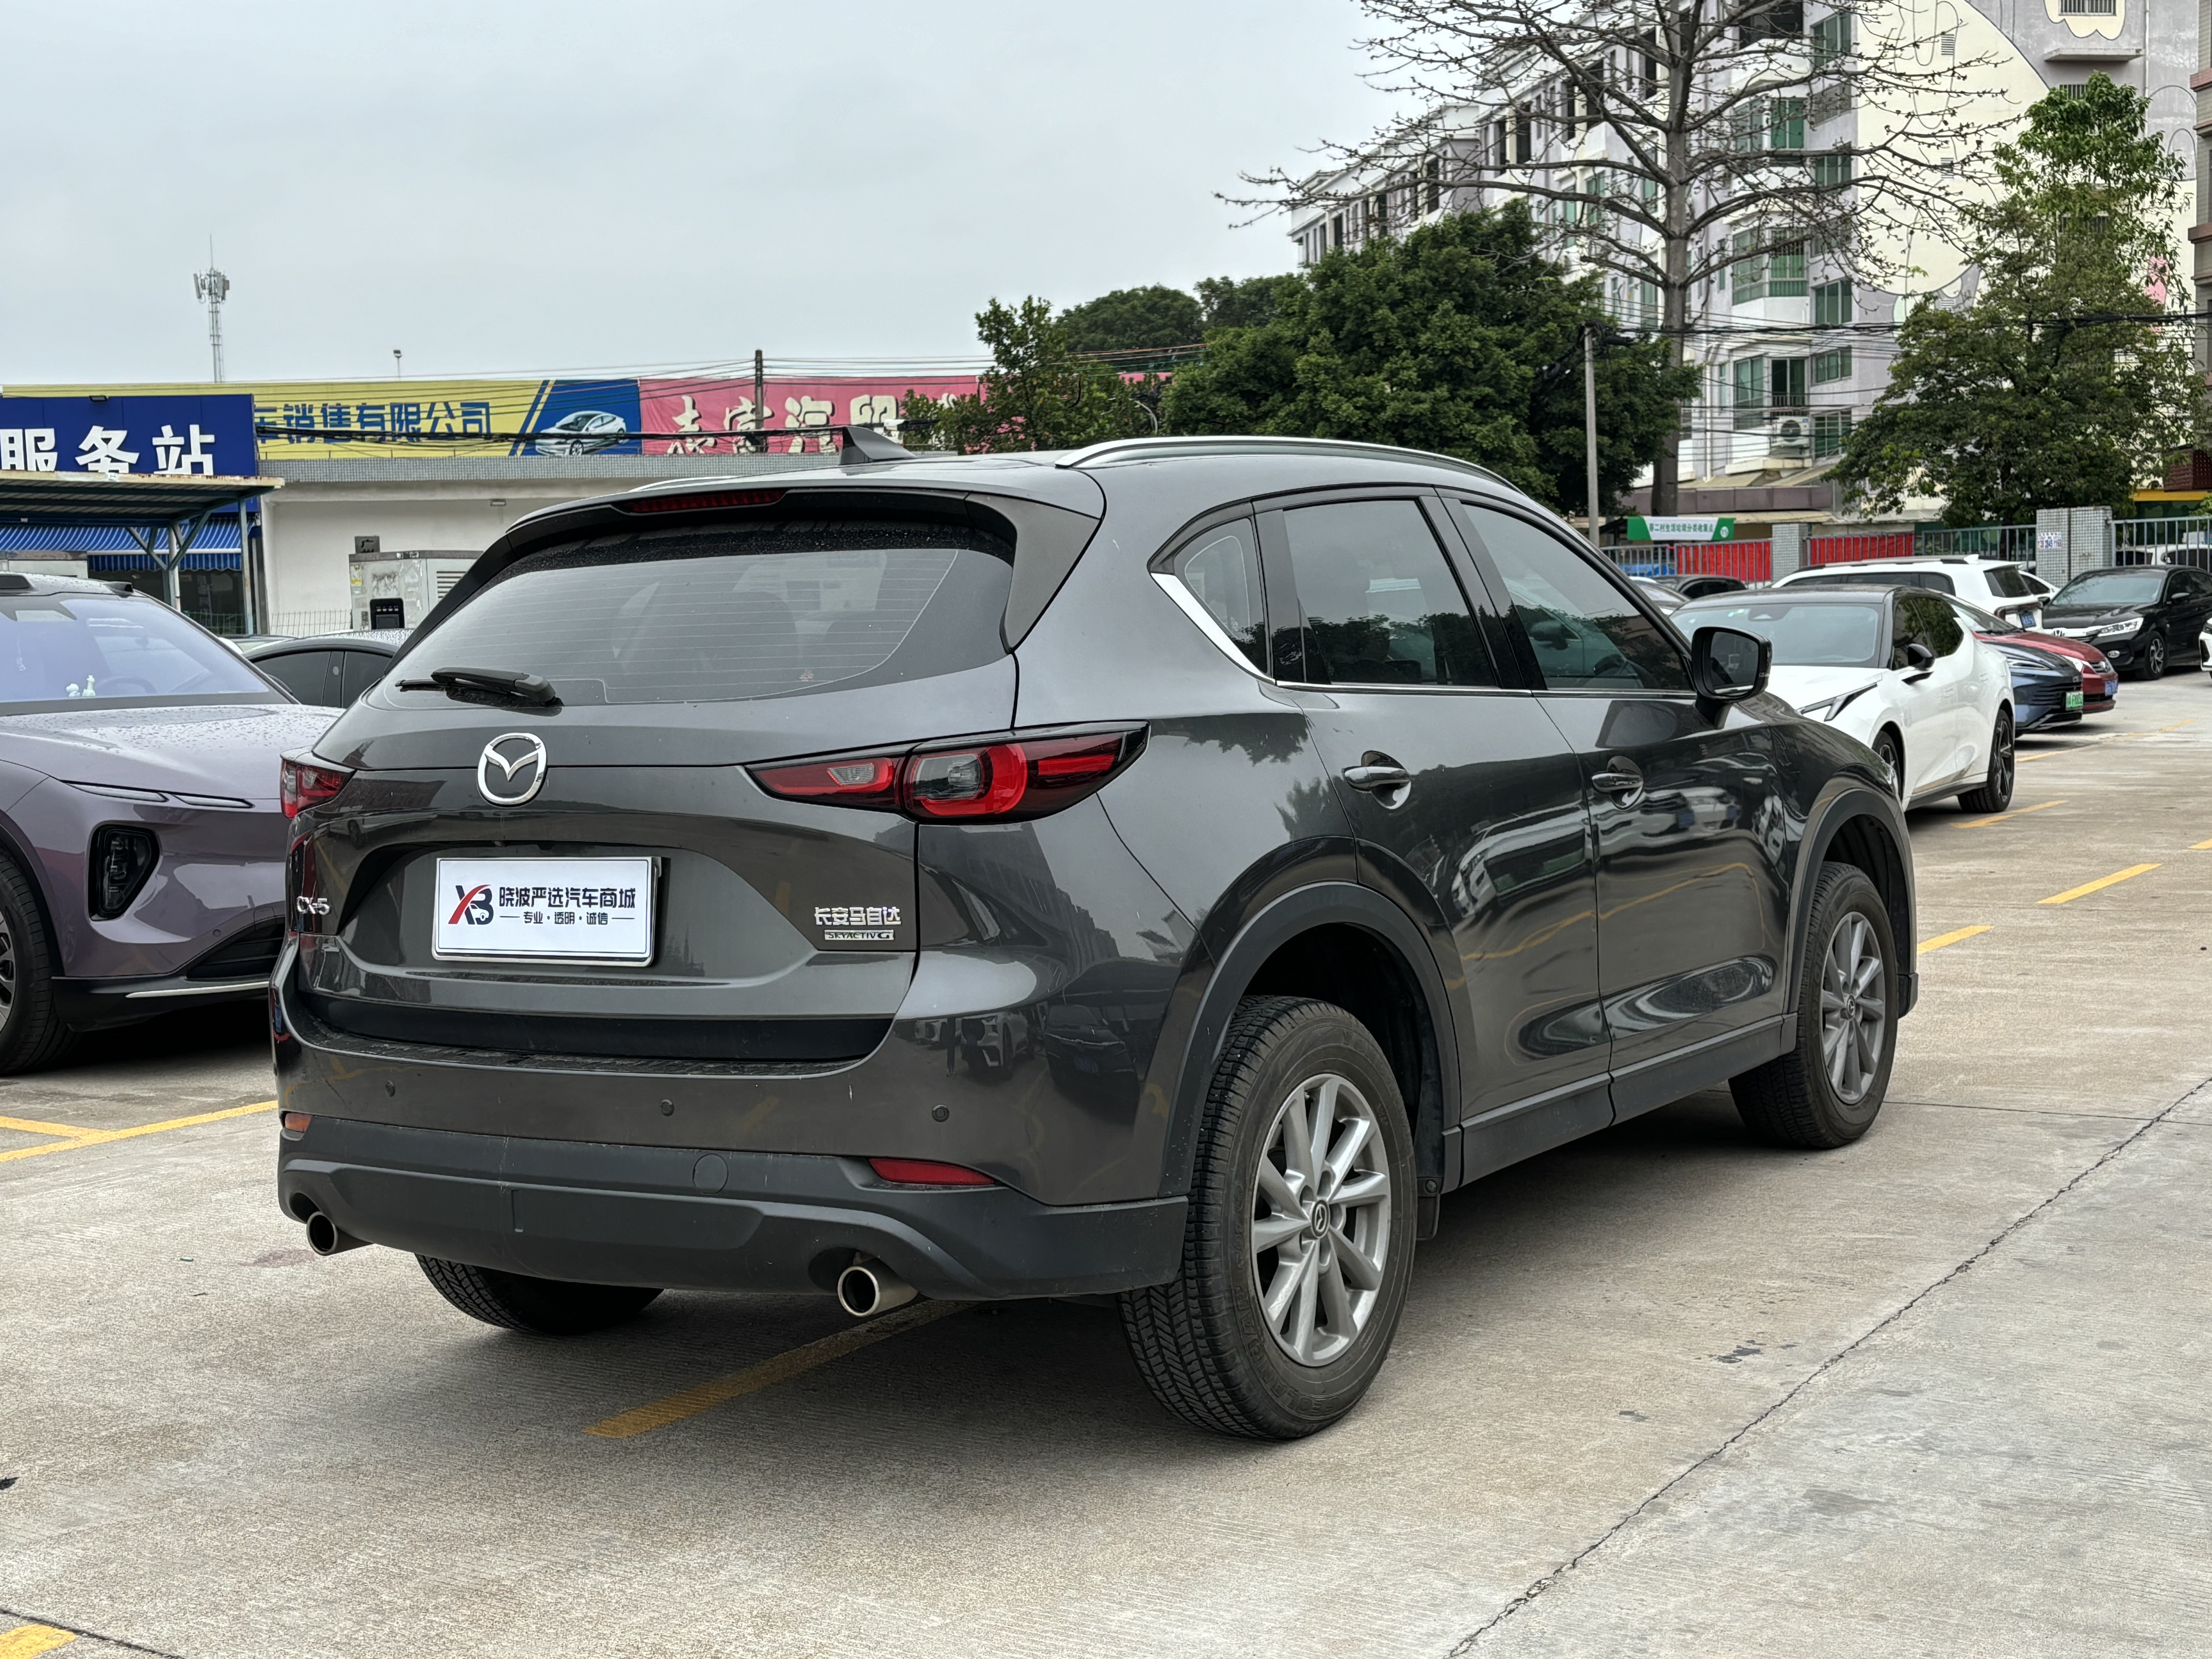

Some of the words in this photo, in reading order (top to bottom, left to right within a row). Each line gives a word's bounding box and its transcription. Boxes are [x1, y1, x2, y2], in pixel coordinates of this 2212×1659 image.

[0, 424, 215, 476] 服务站
[296, 895, 330, 915] CX-5
[499, 887, 635, 908] 晓波严选汽车商城
[814, 906, 902, 926] 长安马自达
